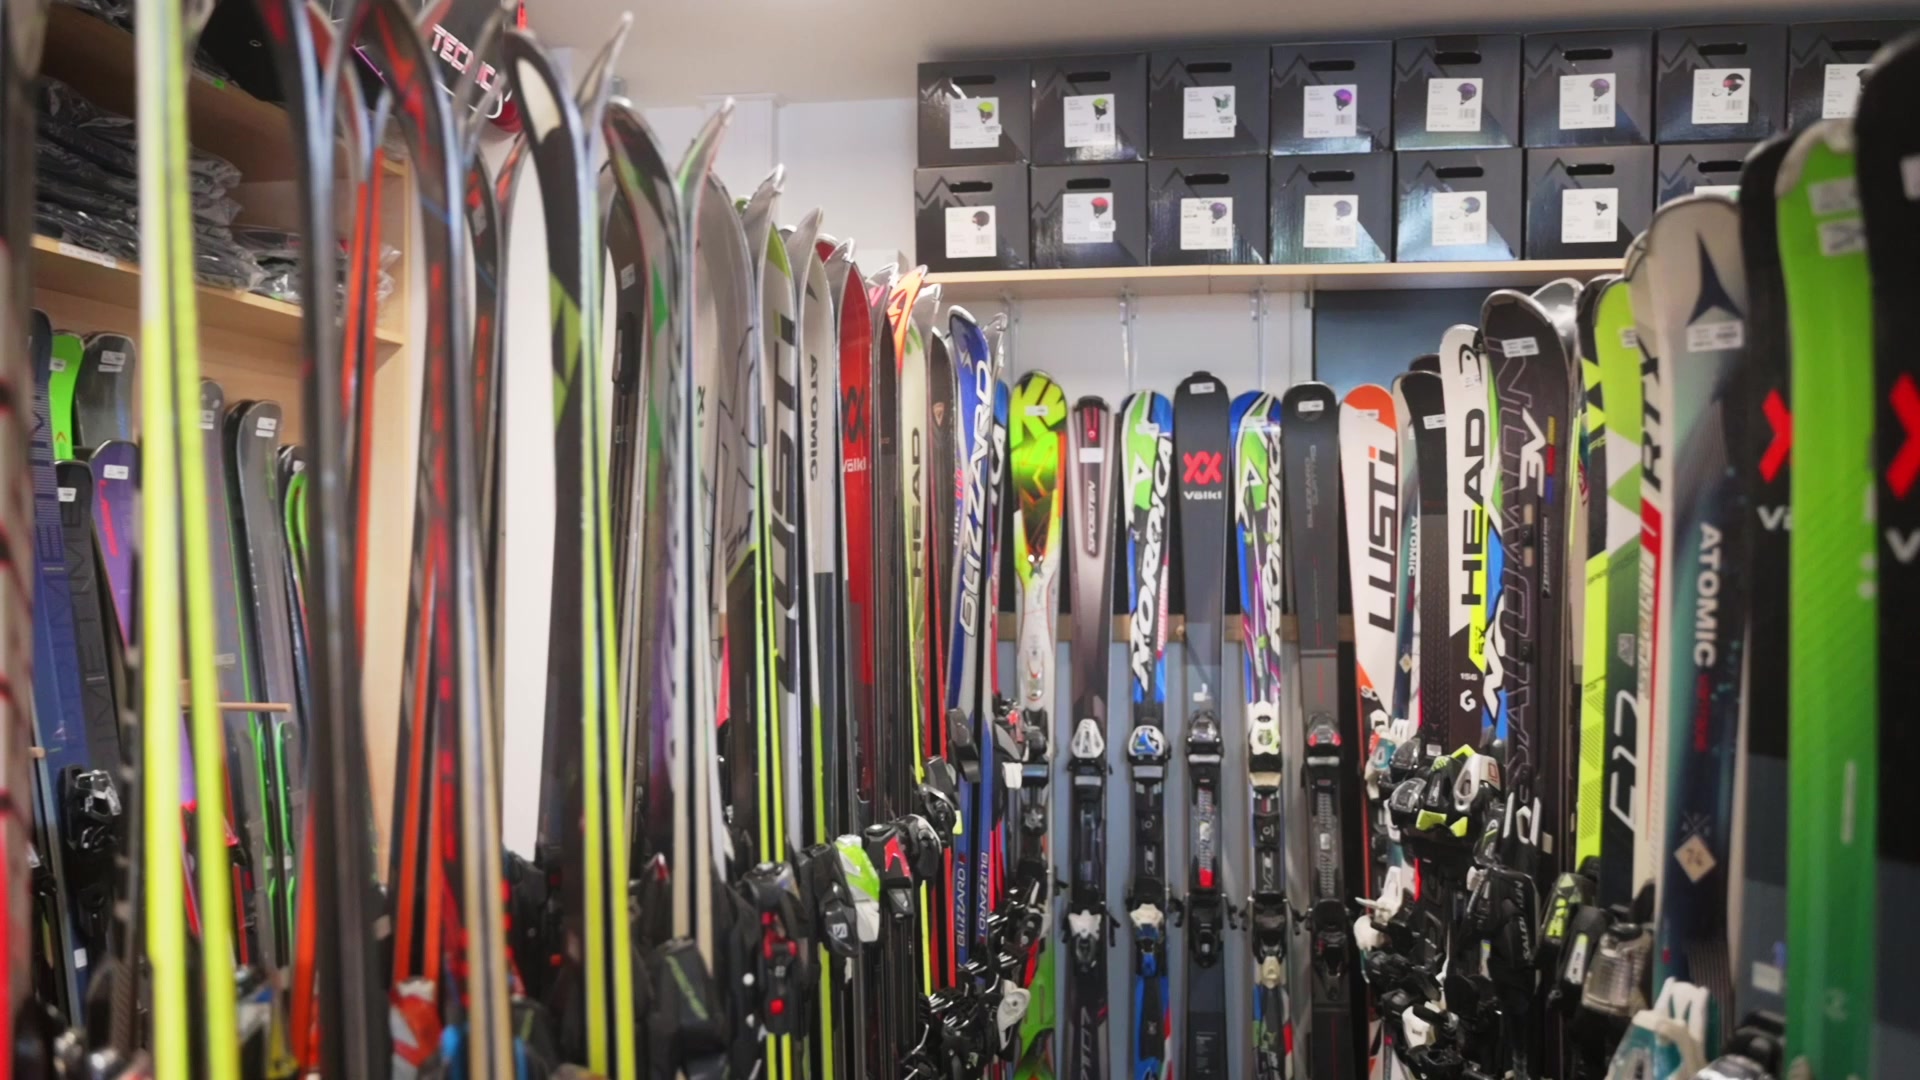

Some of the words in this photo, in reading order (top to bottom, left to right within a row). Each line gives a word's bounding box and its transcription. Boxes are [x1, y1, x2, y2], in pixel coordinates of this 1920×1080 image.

[431, 23, 502, 98] TECIC
[809, 354, 819, 482] ATOMIC
[911, 427, 921, 578] HEAD
[959, 359, 992, 637] BLIZZARD
[1183, 490, 1223, 501] Völkl
[1407, 515, 1418, 577] ATOMIC
[1461, 408, 1485, 606] HEAD
[1131, 437, 1173, 692] NORDICA
[1693, 522, 1722, 668] ATOMIC
[957, 868, 966, 947] BLIZZARD
[979, 852, 988, 930] BLIZZARD
